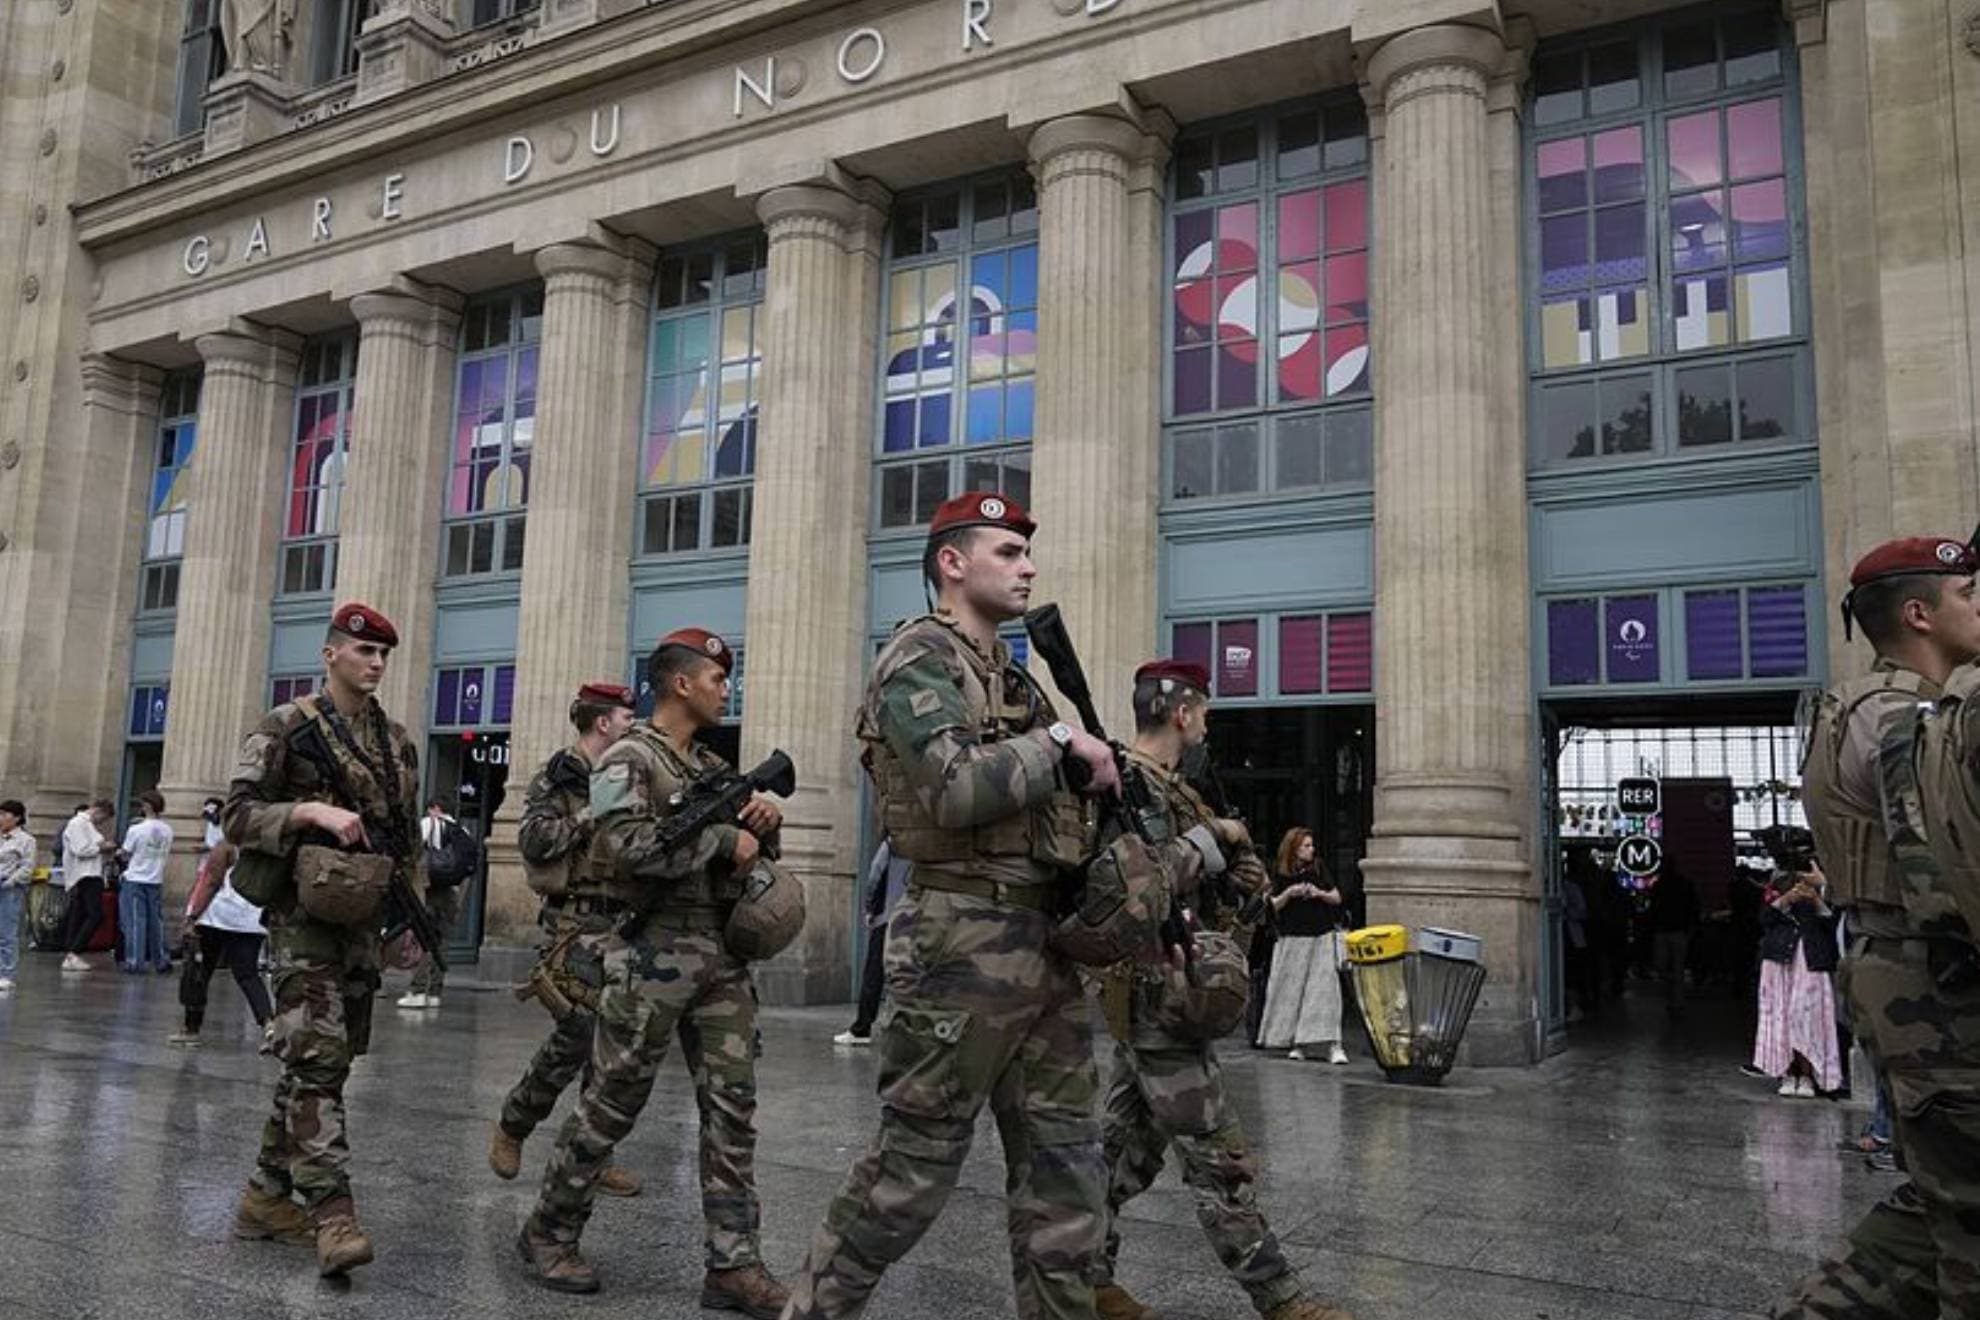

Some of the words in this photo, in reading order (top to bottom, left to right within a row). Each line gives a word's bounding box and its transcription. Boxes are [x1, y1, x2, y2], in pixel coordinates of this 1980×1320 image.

[183, 174, 404, 277] GARE
[504, 104, 621, 184] DU
[1622, 788, 1654, 804] RER
[1627, 845, 1650, 866] M
